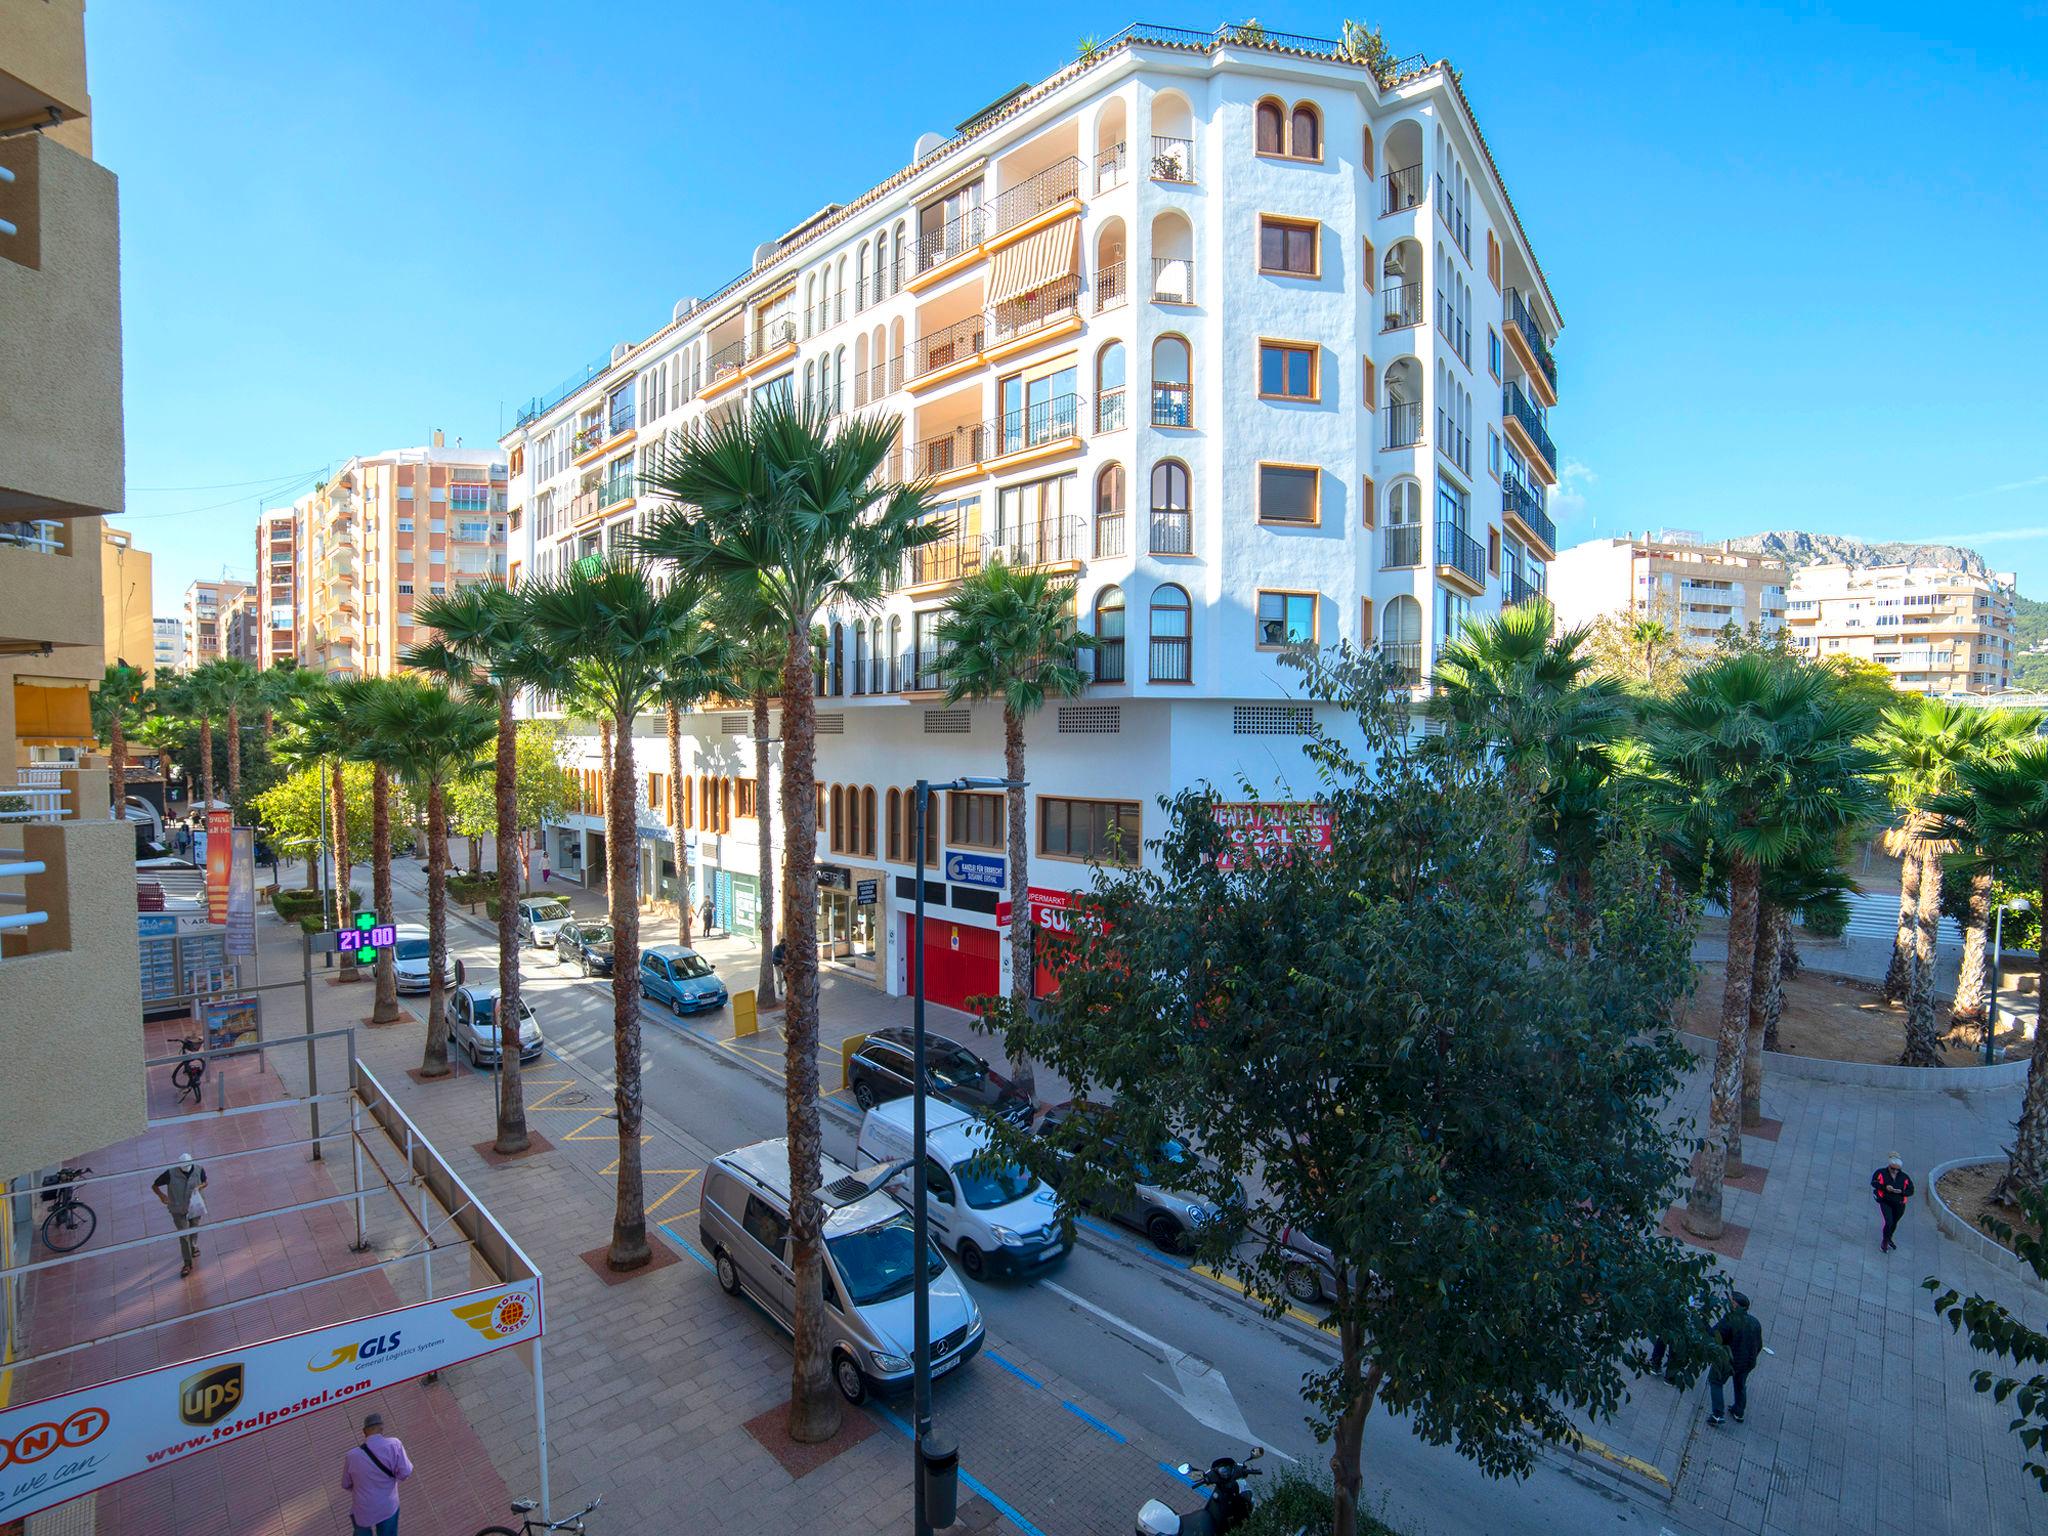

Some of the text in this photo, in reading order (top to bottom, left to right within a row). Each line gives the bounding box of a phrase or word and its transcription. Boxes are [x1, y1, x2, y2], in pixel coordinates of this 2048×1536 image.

[1231, 829, 1323, 843] OCALES
[1028, 893, 1066, 905] UPERMARKT
[341, 927, 394, 950] 21:00
[497, 1295, 526, 1309] TOTAL
[496, 1314, 530, 1333] POSTAL
[354, 1338, 445, 1371] General Logistics Systems
[359, 1330, 402, 1360] GLS
[184, 1378, 240, 1419] ups
[146, 1379, 372, 1463] www.totalpostal.com
[13, 1472, 48, 1498] we
[53, 1453, 110, 1481] can
